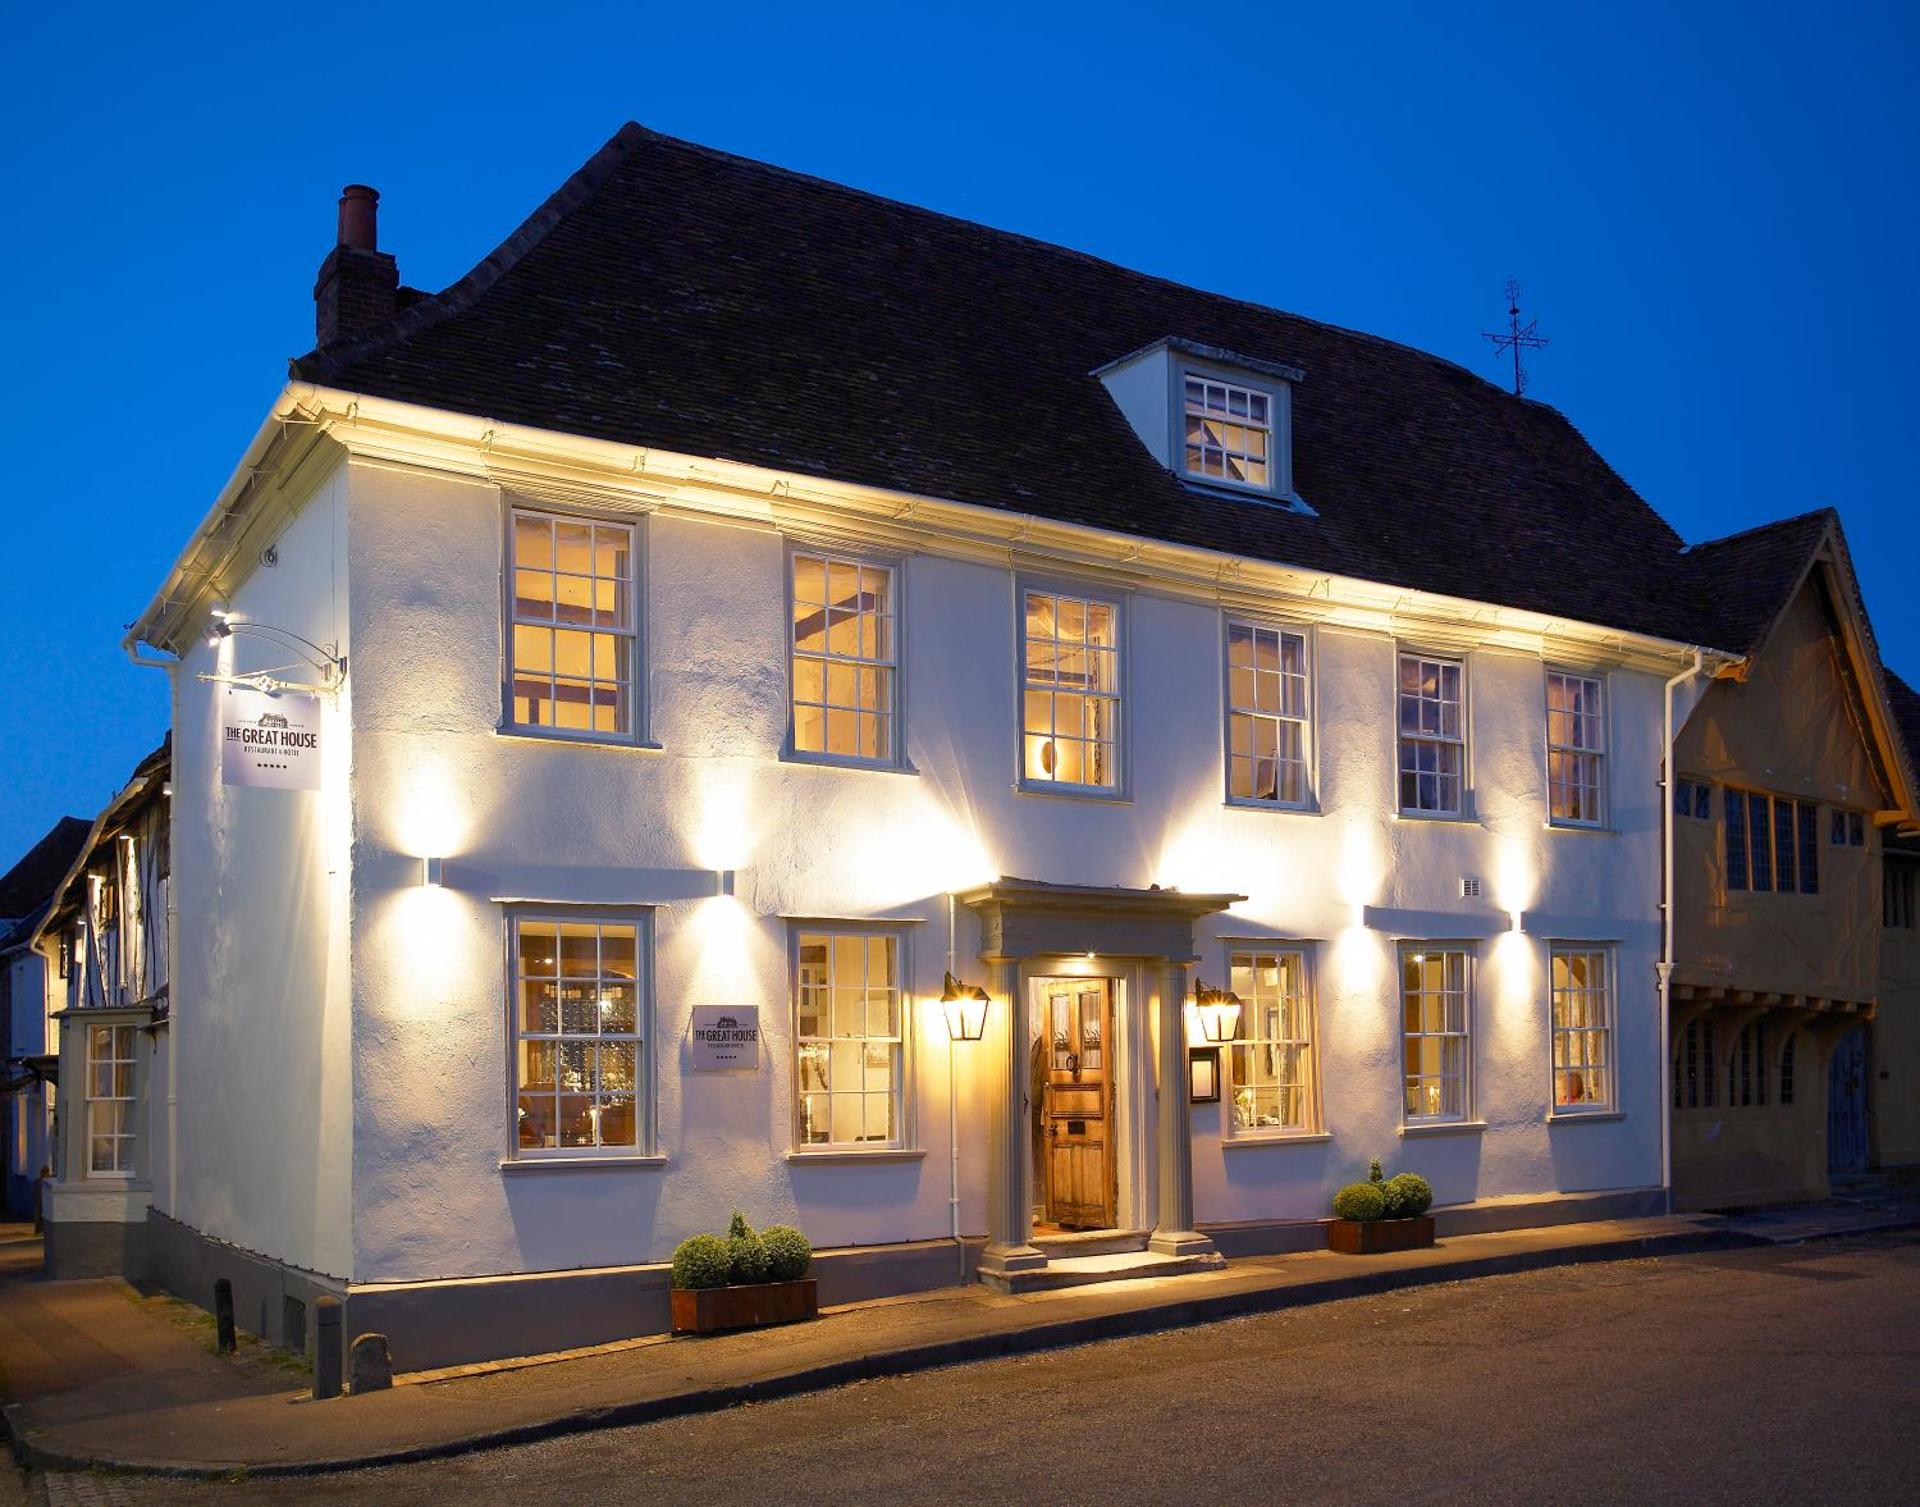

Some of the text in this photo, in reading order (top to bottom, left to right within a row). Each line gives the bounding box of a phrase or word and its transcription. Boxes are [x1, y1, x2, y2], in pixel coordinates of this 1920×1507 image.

[225, 727, 317, 748] THE GREAT HOUSE
[706, 1030, 731, 1041] GREAT
[731, 1030, 757, 1041] HOUSE
